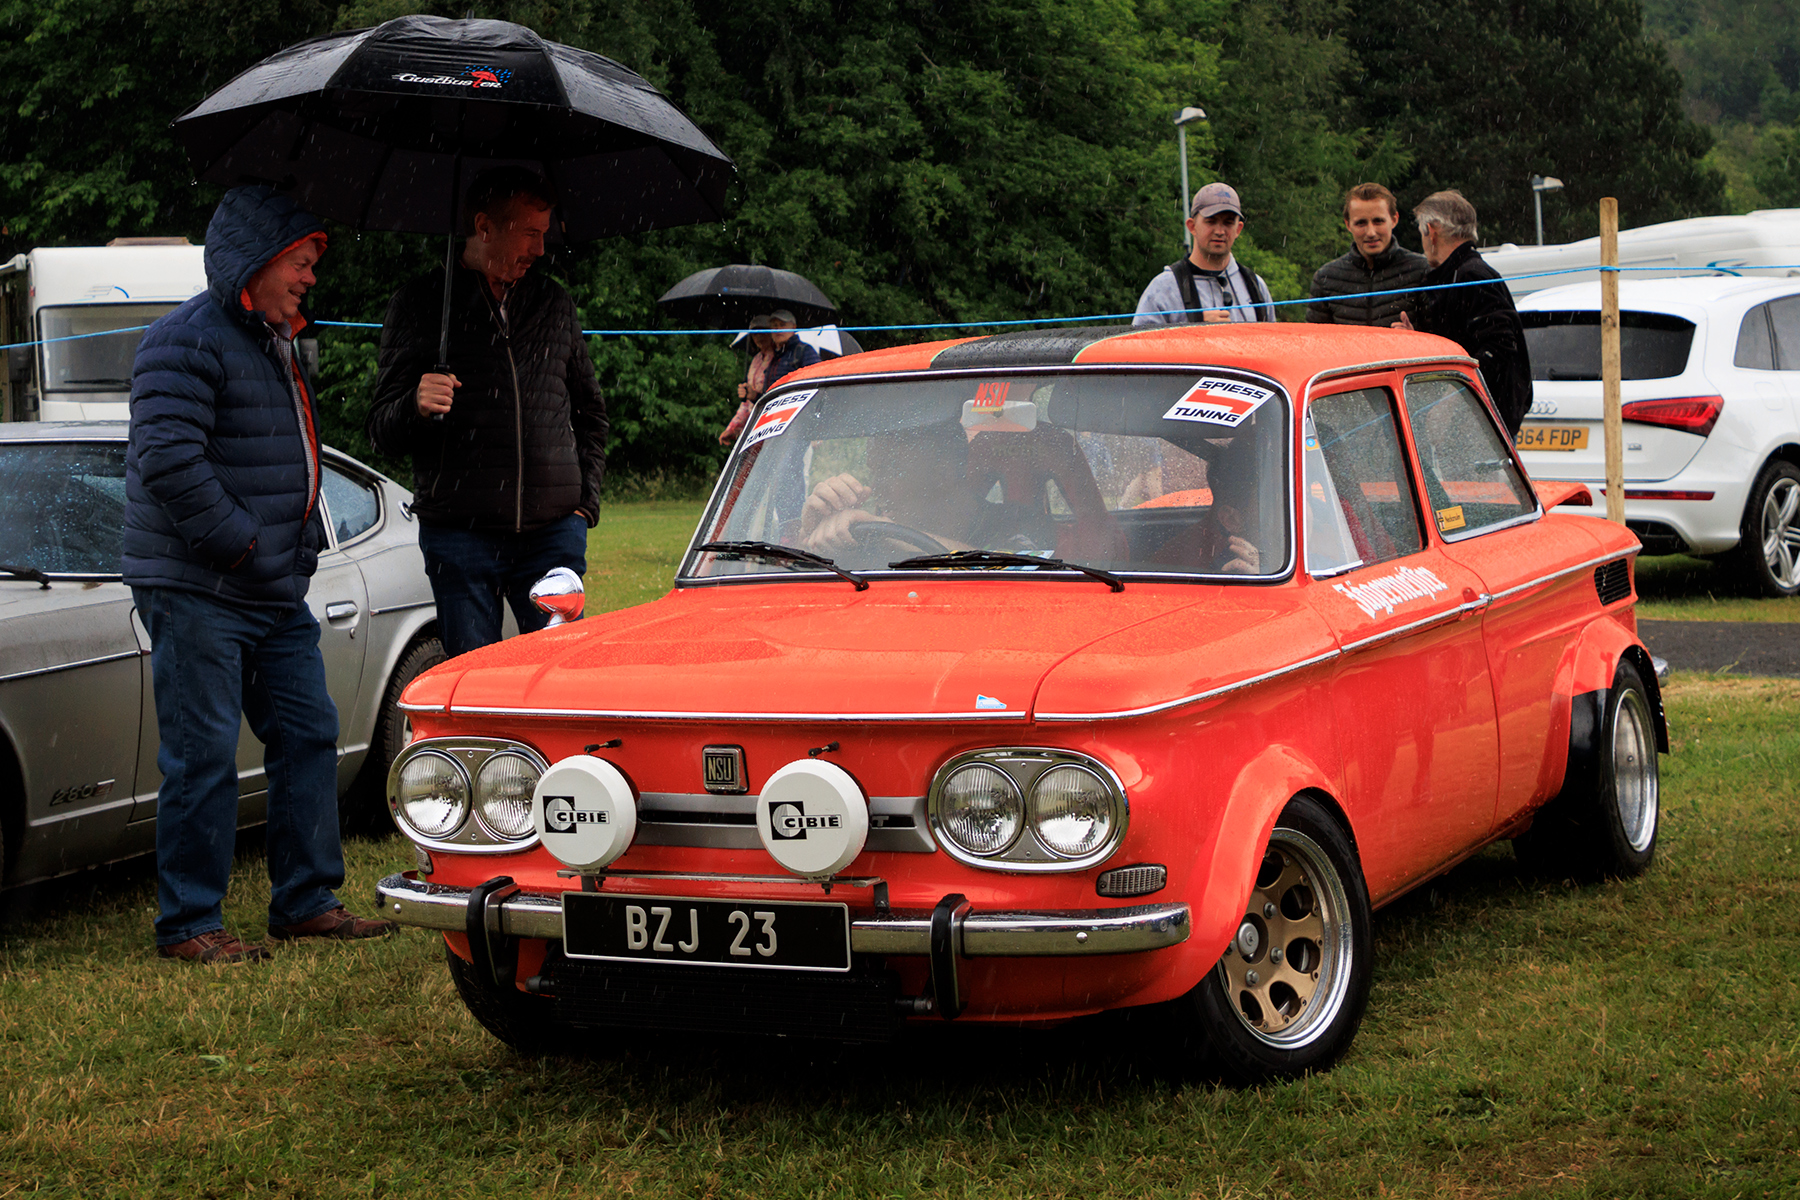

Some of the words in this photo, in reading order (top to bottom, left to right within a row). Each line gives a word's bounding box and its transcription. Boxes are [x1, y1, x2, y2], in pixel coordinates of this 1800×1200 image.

[973, 382, 1011, 407] NSU
[1199, 380, 1267, 400] SPIESS
[763, 392, 811, 414] SPIESS
[1174, 407, 1240, 423] TUNING
[1549, 429, 1582, 446] FDP
[707, 757, 732, 781] NSU
[626, 905, 699, 953] BZJ
[727, 910, 777, 957] 23
